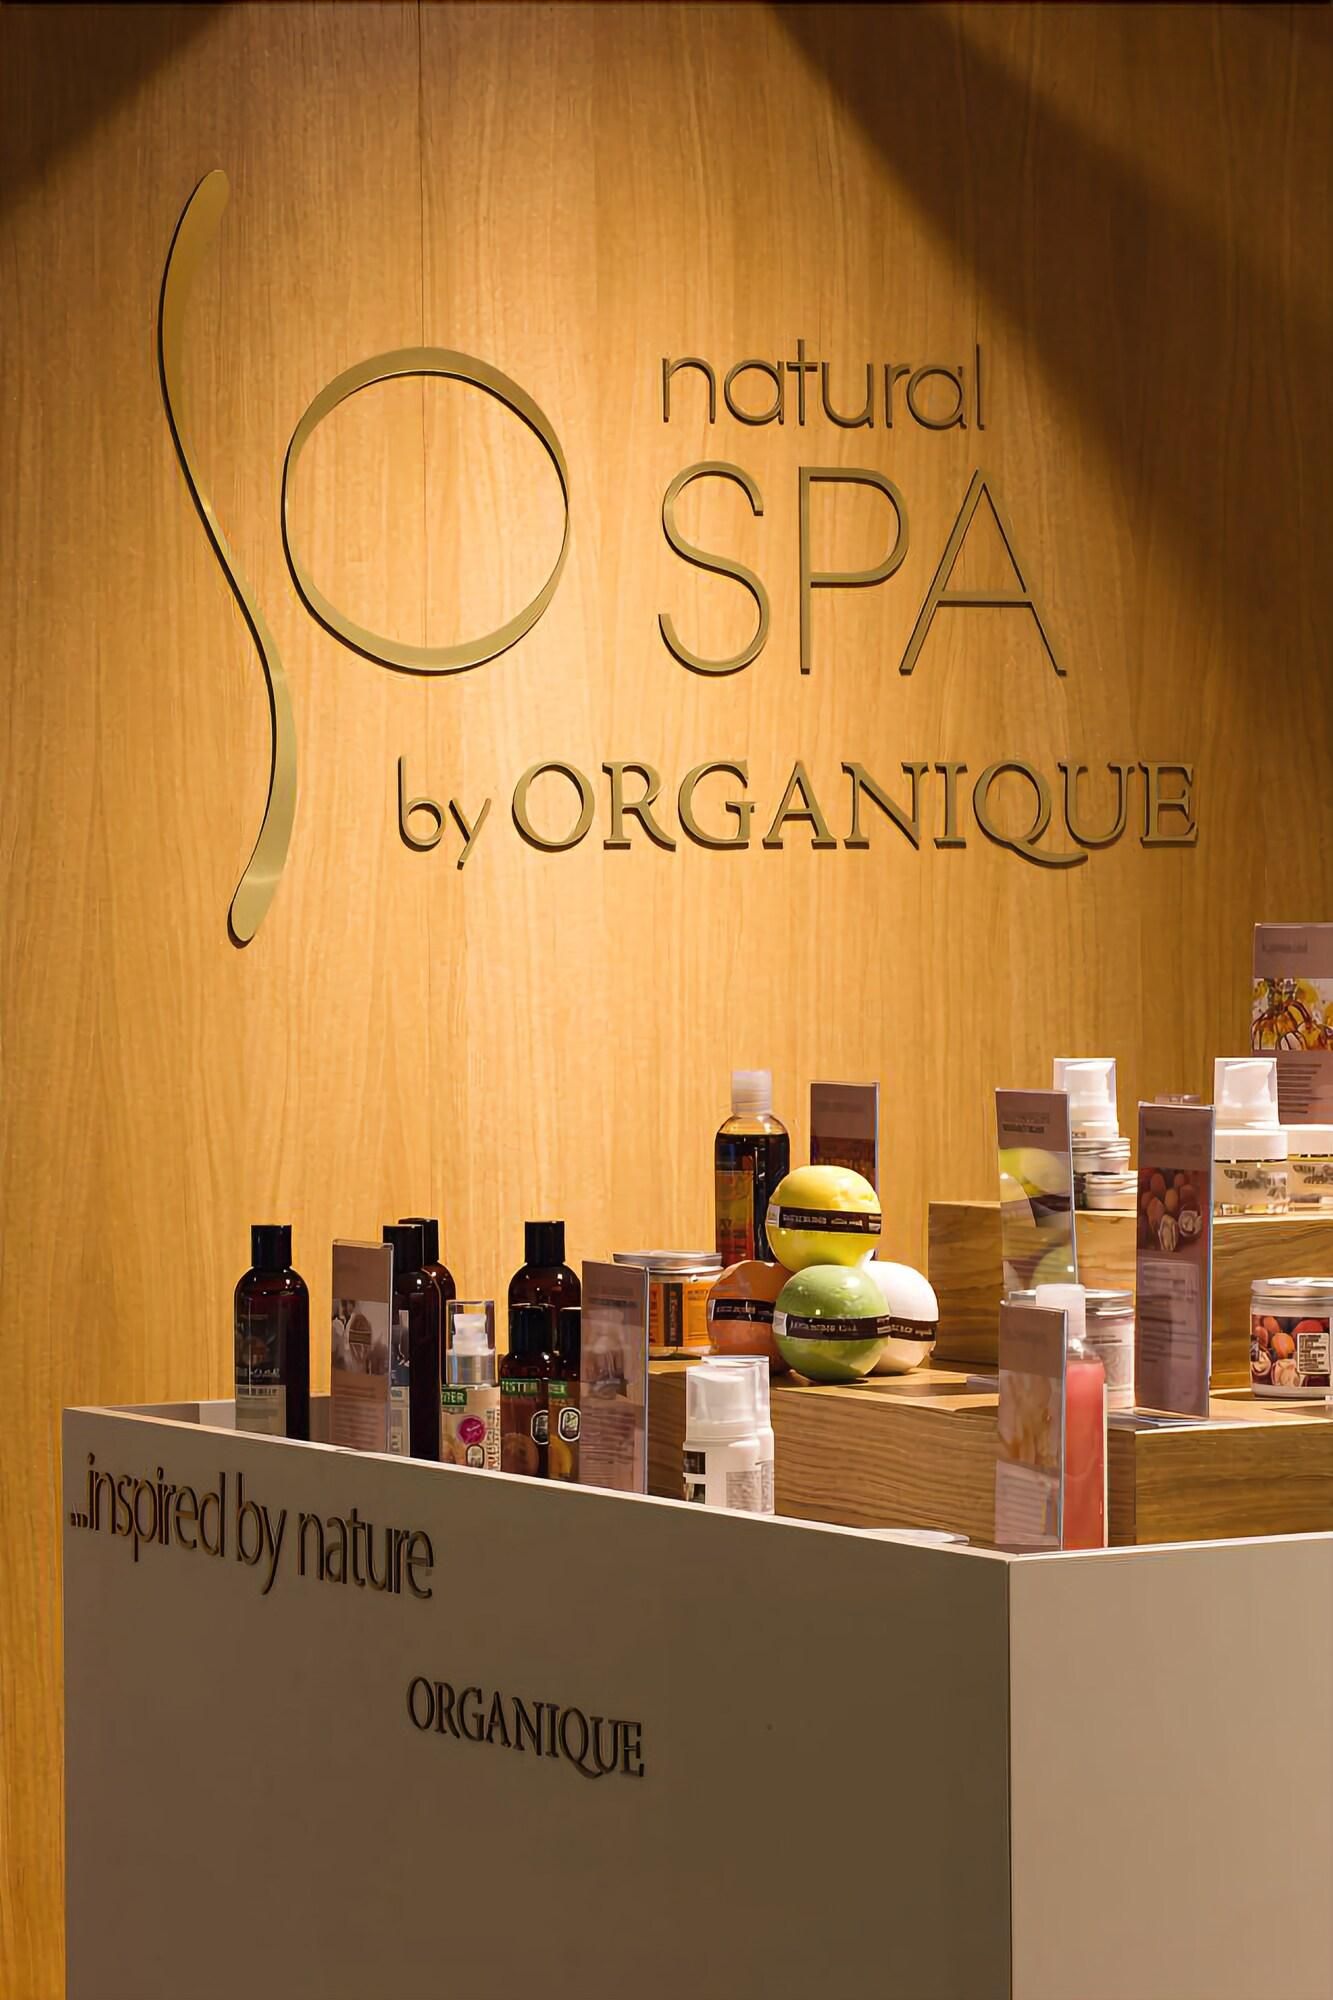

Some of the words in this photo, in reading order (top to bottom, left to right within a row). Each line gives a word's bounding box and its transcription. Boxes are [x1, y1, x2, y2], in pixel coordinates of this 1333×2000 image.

[661, 338, 986, 431] natural
[657, 460, 1067, 678] SPA
[397, 754, 492, 870] by
[511, 759, 1199, 869] ORGANIQUE
[235, 1471, 288, 1596] by
[297, 1507, 435, 1600] nature
[405, 1675, 646, 1781] ORGANIQUE
